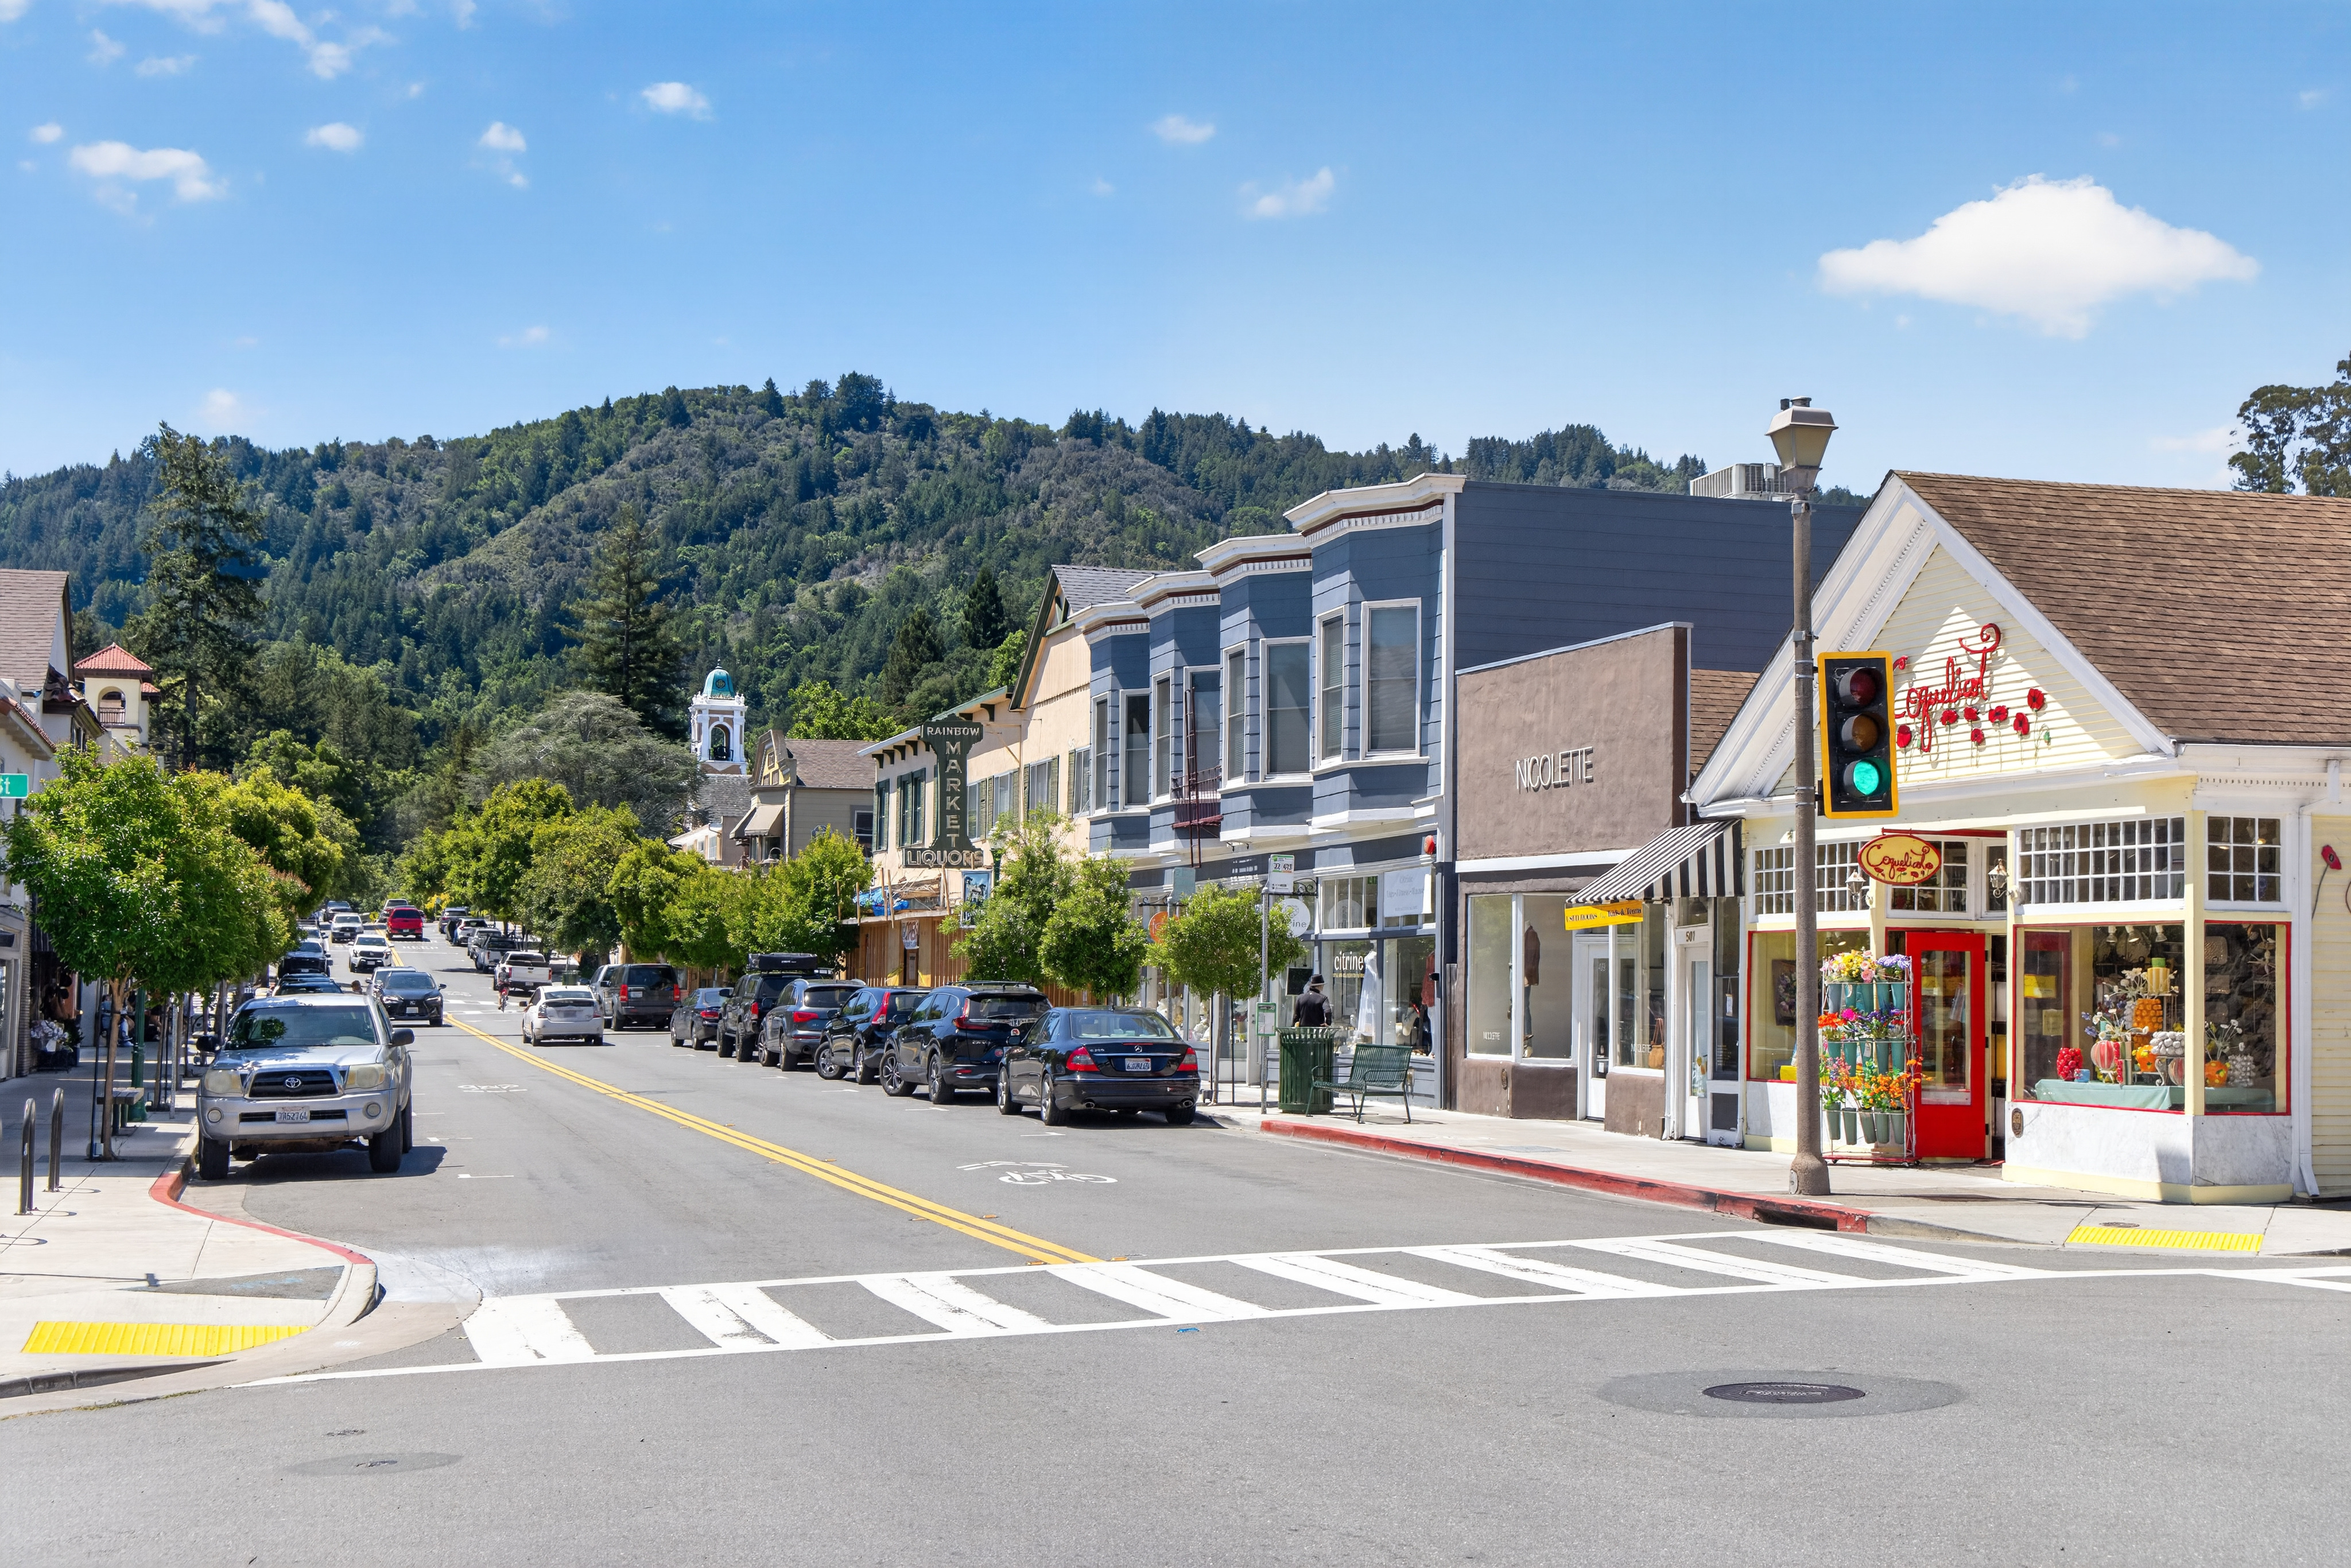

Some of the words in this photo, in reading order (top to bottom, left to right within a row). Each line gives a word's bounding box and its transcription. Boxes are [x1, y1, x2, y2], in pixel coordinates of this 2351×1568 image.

[1894, 623, 2001, 752] oquelicot
[927, 727, 979, 736] RAINBOW
[1516, 746, 1593, 790] NICOLETTE
[945, 741, 962, 847] MARKET
[1866, 844, 1930, 879] Coquelicot
[1334, 950, 1364, 971] citrine
